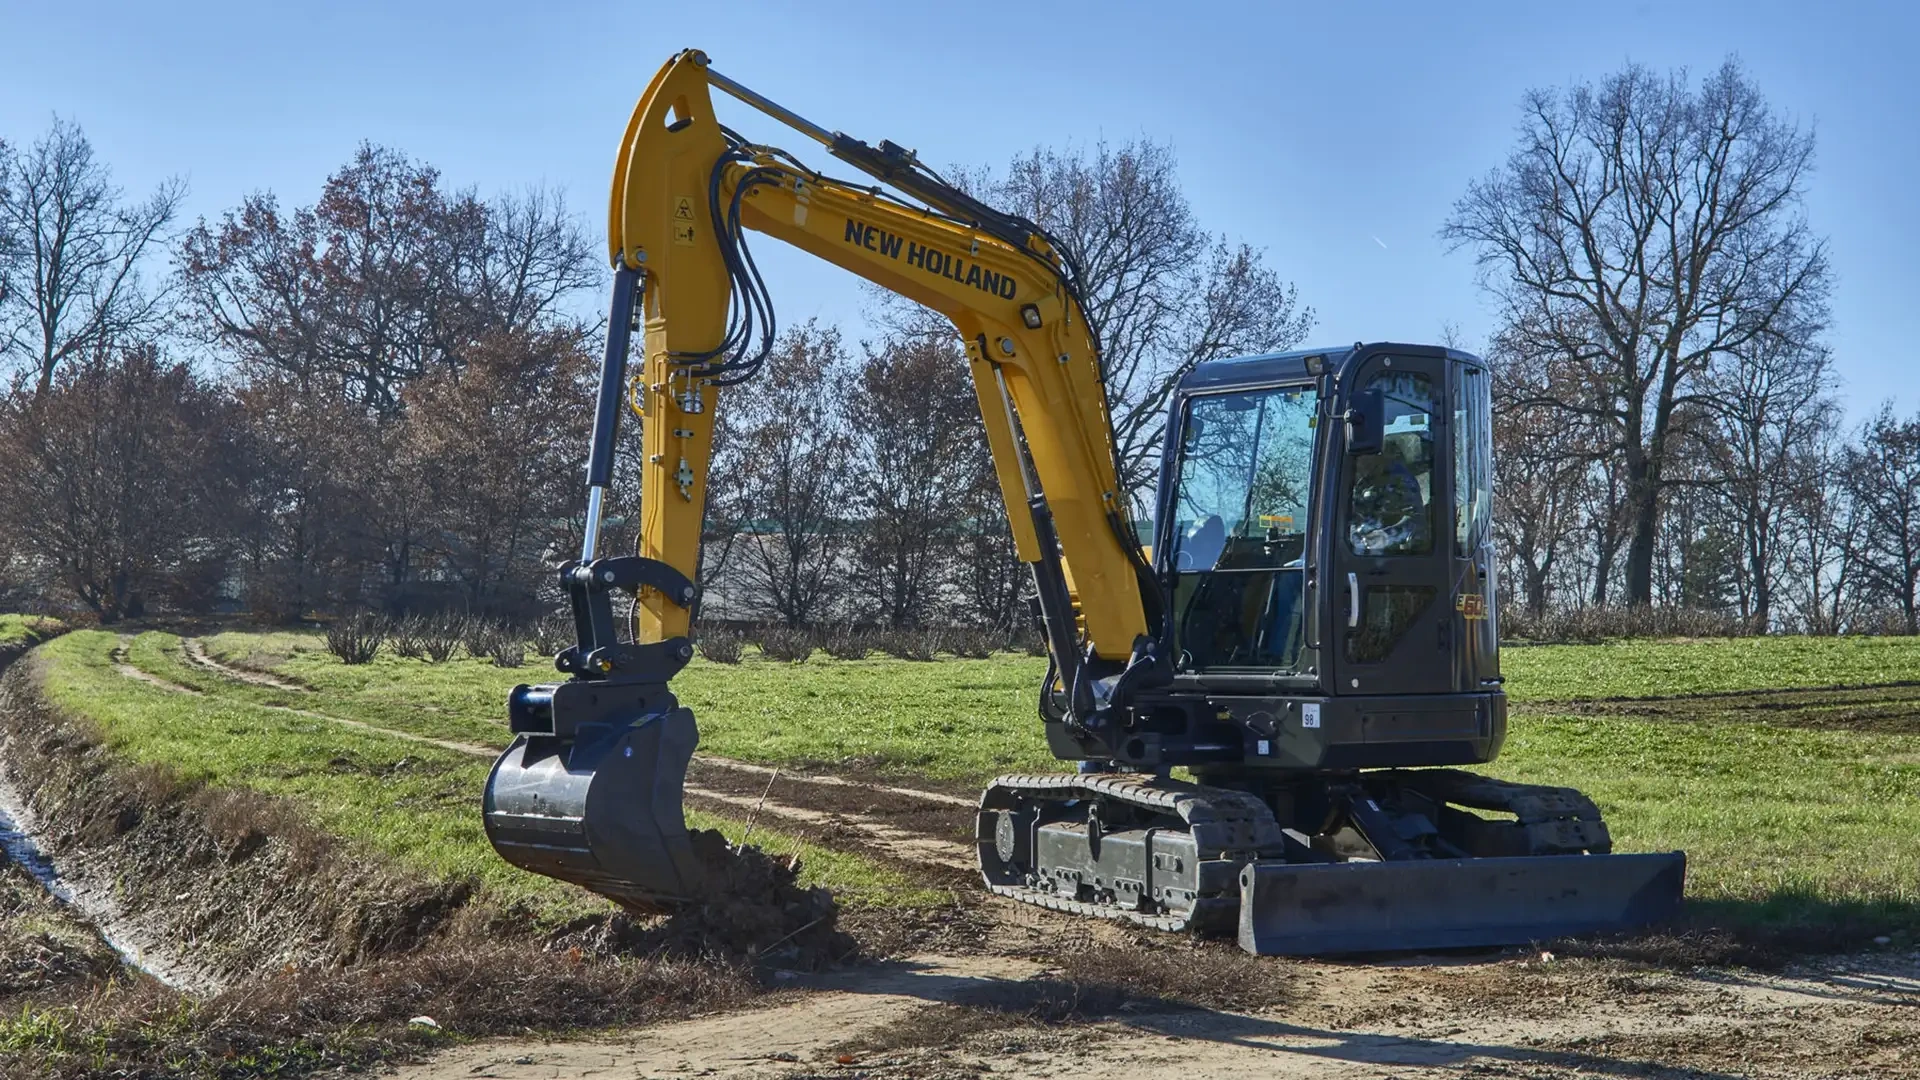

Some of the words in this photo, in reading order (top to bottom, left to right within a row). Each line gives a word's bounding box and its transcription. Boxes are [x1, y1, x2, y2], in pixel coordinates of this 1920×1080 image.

[844, 219, 903, 260] NEW
[907, 241, 1017, 300] HOLLAND
[1304, 713, 1314, 726] 98
